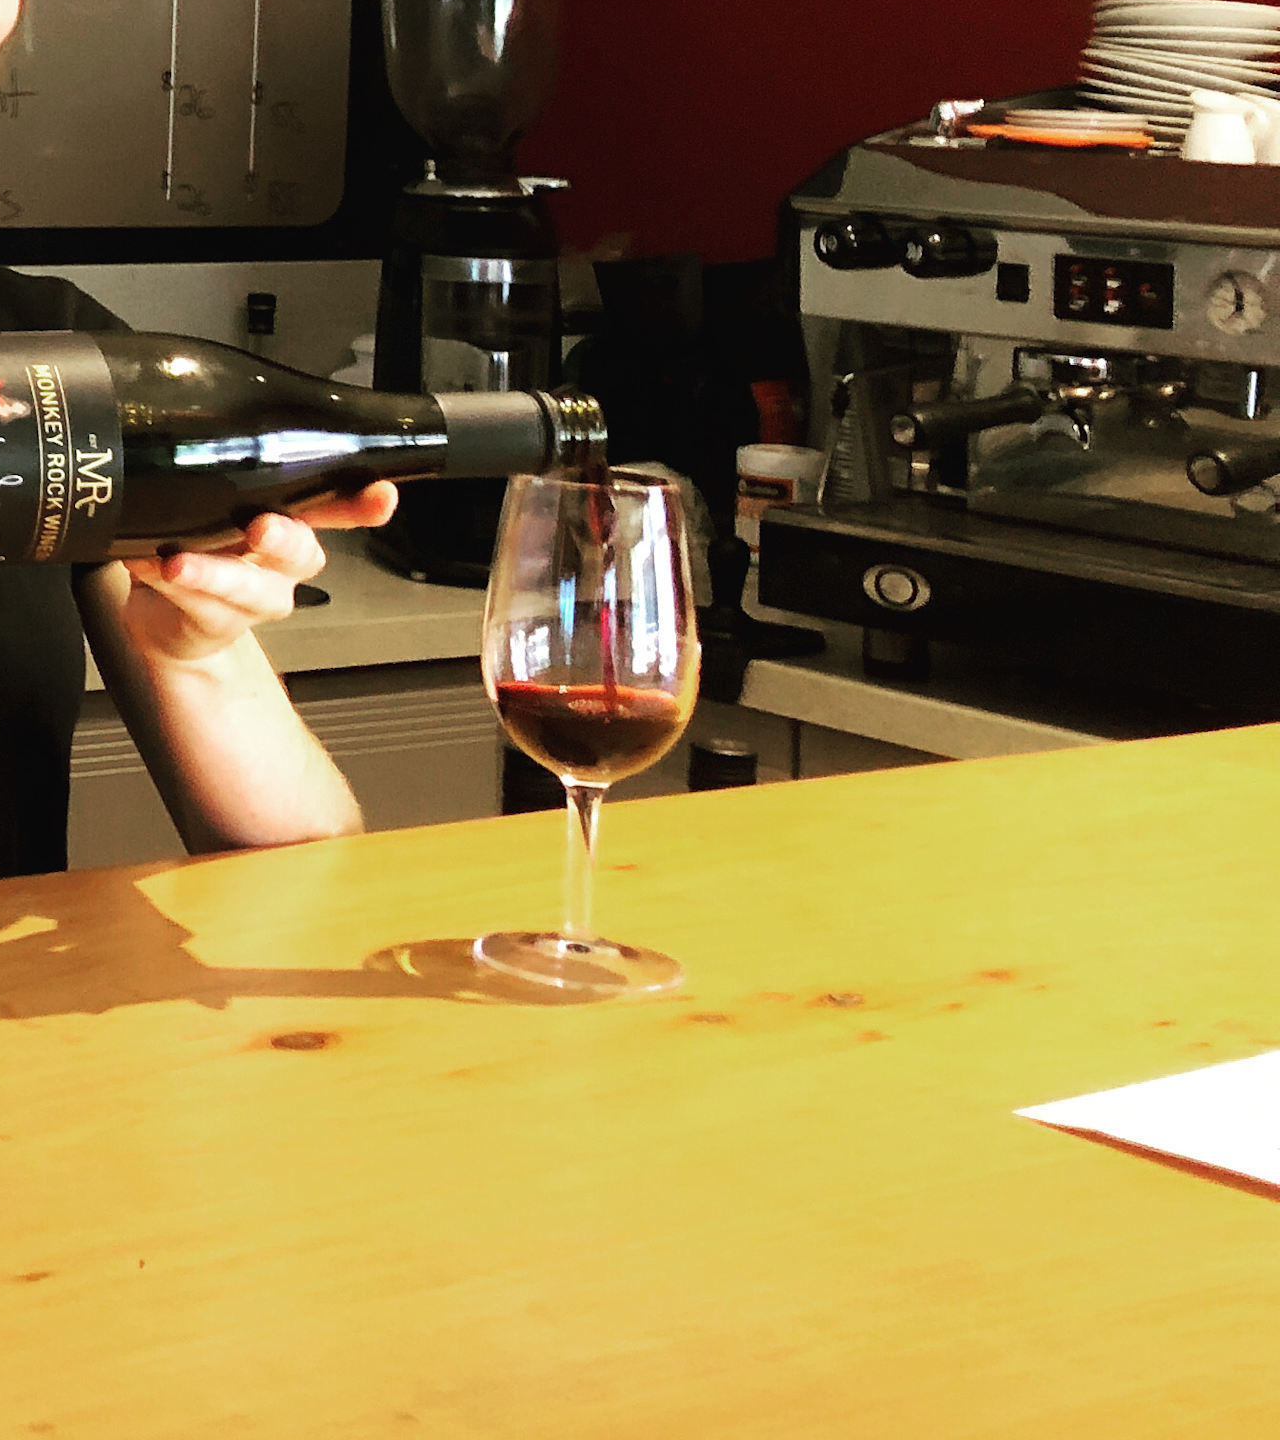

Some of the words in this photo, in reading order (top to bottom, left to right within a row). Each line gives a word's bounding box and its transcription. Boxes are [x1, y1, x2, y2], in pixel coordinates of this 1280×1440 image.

[32, 363, 64, 447] MONKEY
[46, 452, 66, 510] ROCK
[75, 448, 113, 511] MR
